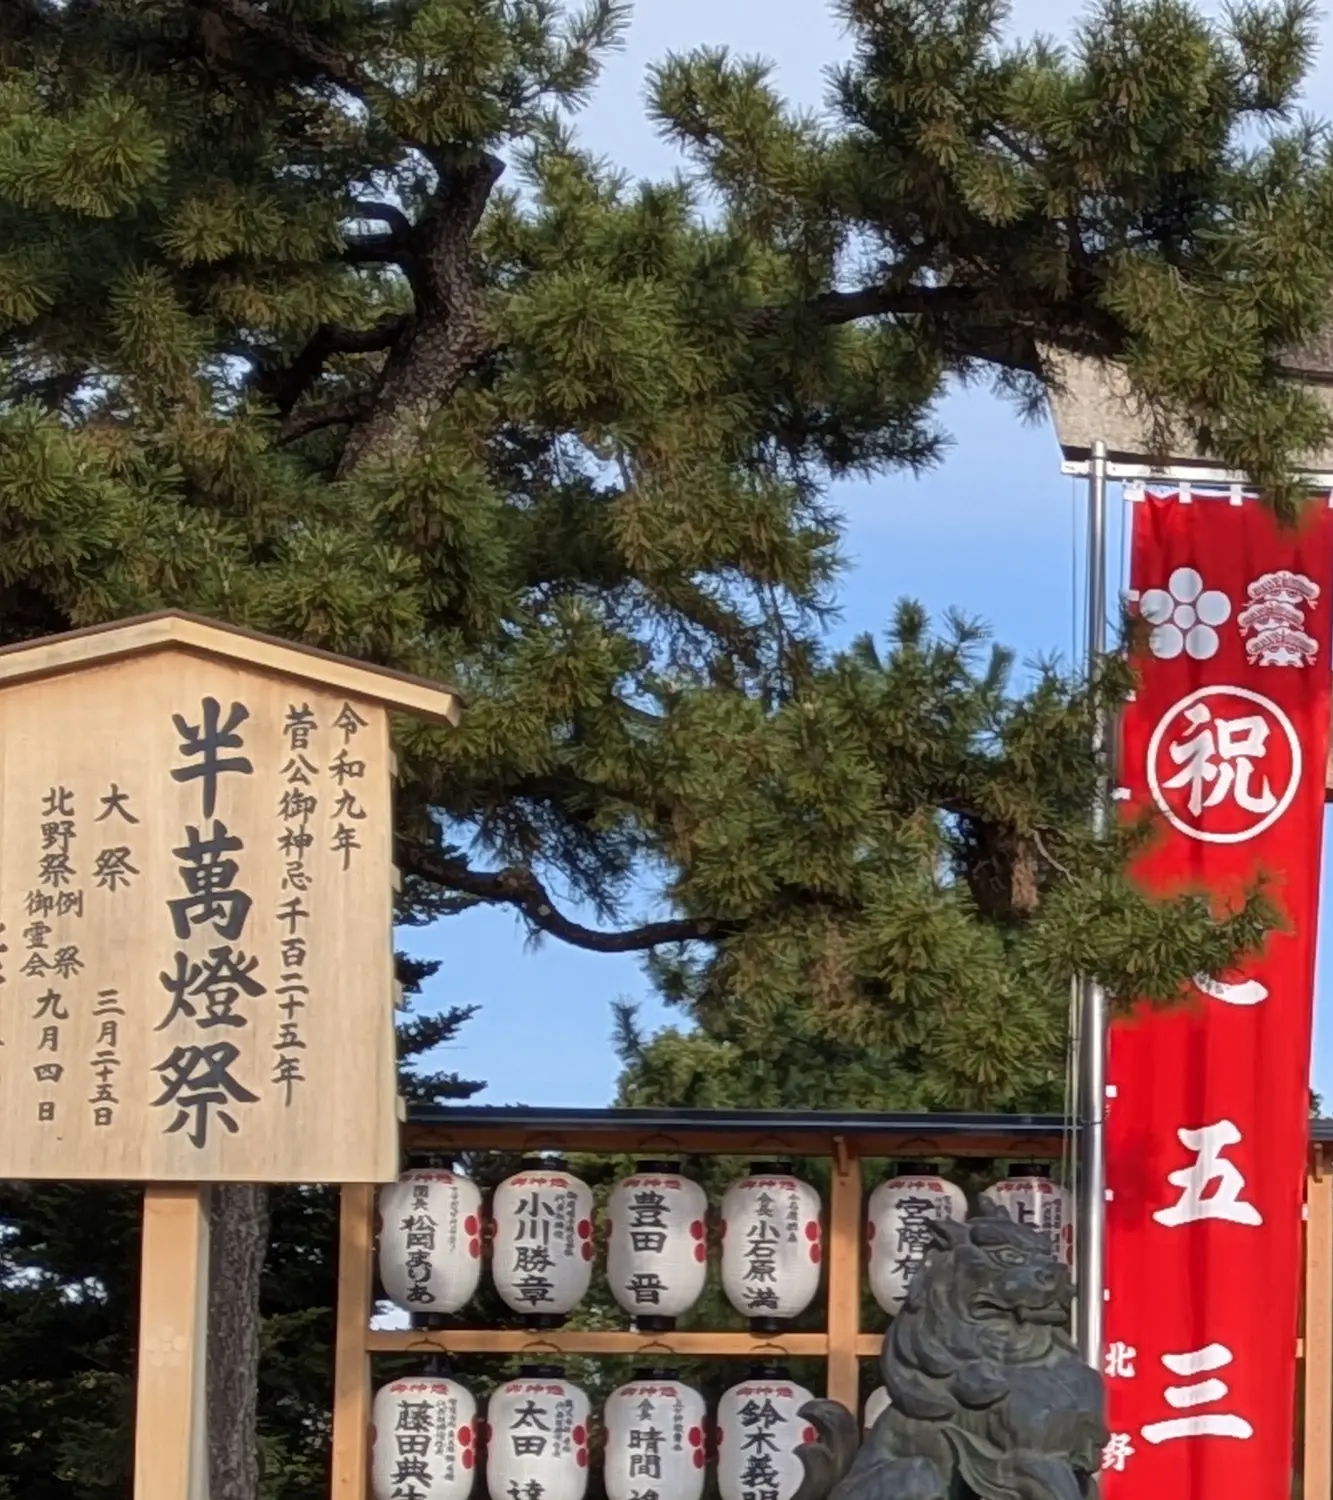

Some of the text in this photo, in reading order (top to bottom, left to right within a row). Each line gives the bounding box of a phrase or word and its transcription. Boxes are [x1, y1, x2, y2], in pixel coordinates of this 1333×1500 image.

[329, 701, 369, 872] 令和九年
[1163, 702, 1278, 817] 祝
[38, 786, 77, 888] 北野祭
[20, 889, 53, 980] 御霊会
[88, 784, 141, 1129] 大祭 三月二十五日
[148, 696, 267, 1149] 半萬燈祭
[271, 703, 320, 1107] 菅公御神忌千百二十五年
[32, 988, 70, 1123] 九月四日
[399, 1214, 438, 1304] 松岡まりあ
[512, 1191, 556, 1306] 小川勝章
[742, 1220, 781, 1310] 小石原満
[892, 1196, 936, 1313] 宮階有
